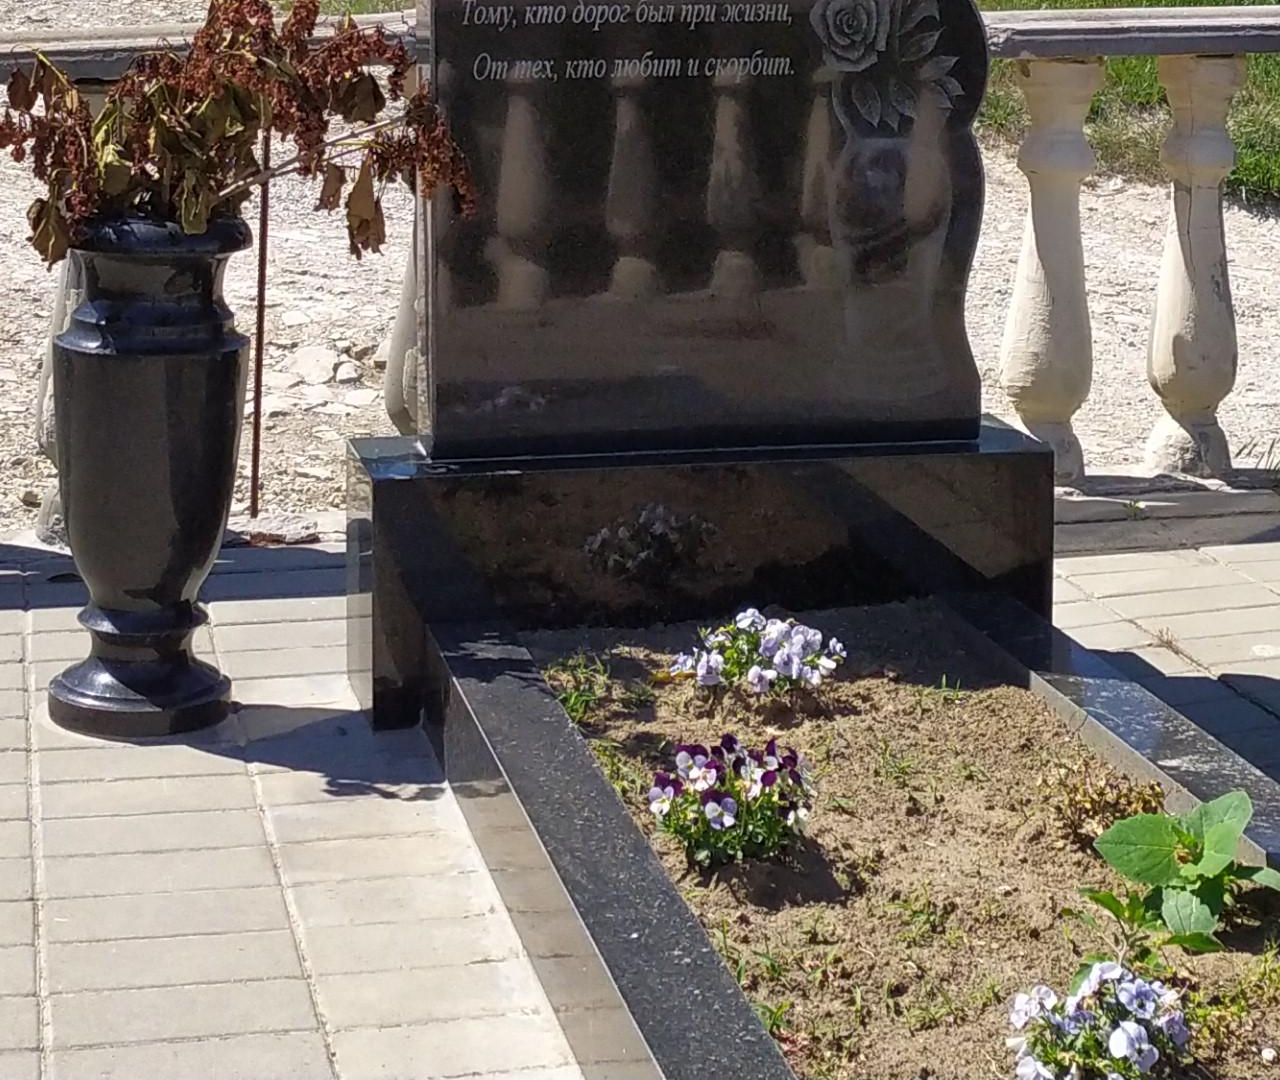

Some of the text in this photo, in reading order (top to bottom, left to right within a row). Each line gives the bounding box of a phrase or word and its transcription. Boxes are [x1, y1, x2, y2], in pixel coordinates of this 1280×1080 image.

[524, 4, 566, 25] кто
[681, 3, 717, 31] при
[721, 3, 793, 25] жизни,
[473, 49, 795, 84] От тех, кто любит и скорбит.
